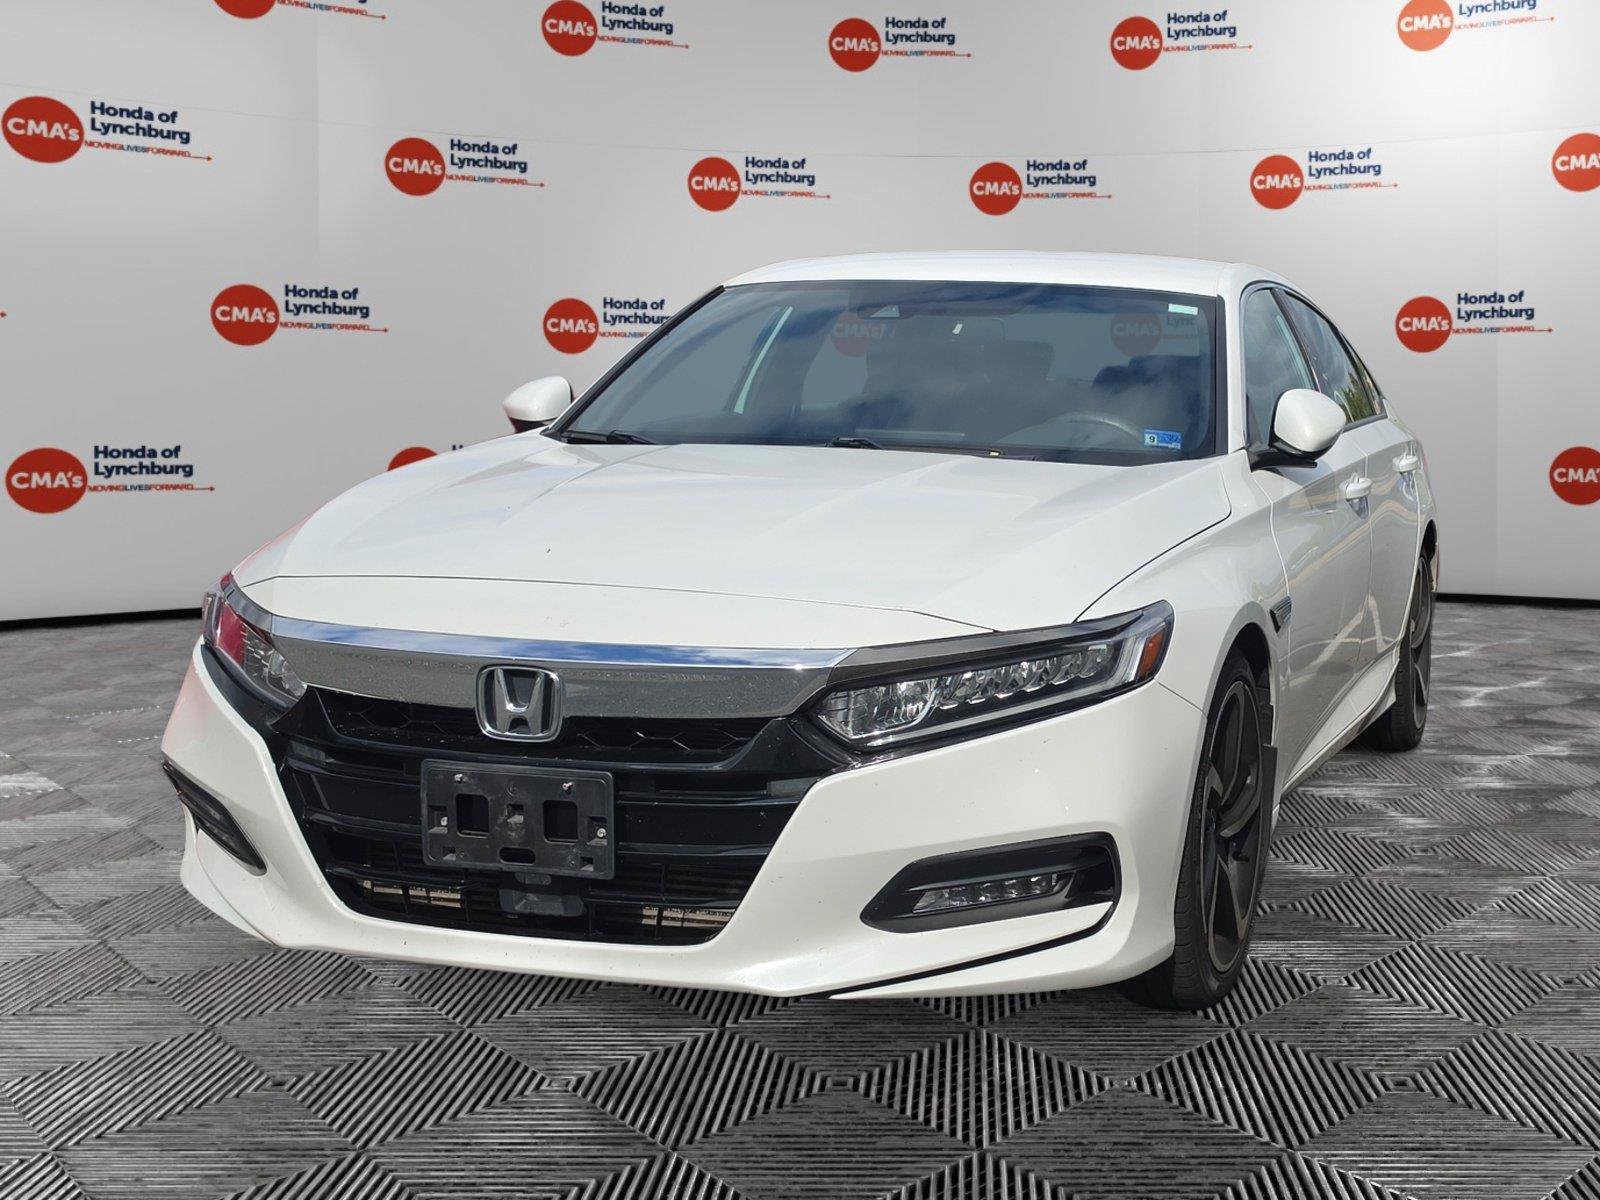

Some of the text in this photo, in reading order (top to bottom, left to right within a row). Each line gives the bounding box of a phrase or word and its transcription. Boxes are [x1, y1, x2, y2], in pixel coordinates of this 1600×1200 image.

[602, 1, 665, 17] Honda of
[1458, 0, 1537, 17] Lynchburg
[602, 15, 674, 35] Lynchburg
[885, 17, 946, 29] Honda of
[1167, 10, 1227, 24] Honda of
[1400, 13, 1451, 32] CMA's
[545, 19, 595, 37] CMA's
[1167, 25, 1237, 40] Lynchburg
[832, 37, 879, 51] CMA's
[885, 31, 956, 45] Lynchburg
[1113, 35, 1160, 50] CMA's
[90, 101, 178, 124] Honda of
[6, 117, 80, 141] CMA's
[90, 117, 191, 144] Lynchburg
[450, 139, 518, 155] Honda of
[1308, 148, 1371, 162] Honda of
[389, 157, 443, 175] CMA's
[450, 154, 528, 173] Lynchburg
[745, 157, 806, 169] Honda of
[1026, 159, 1087, 171] Honda of
[1555, 152, 1600, 171] CMA'
[745, 170, 816, 186] Lynchburg
[1308, 163, 1382, 179] Lynchburg
[691, 176, 739, 192] CMA's
[1026, 173, 1097, 187] Lynchburg
[1253, 173, 1300, 190] CMA's
[972, 181, 1020, 196] CMA's
[284, 284, 359, 300] Honda of
[1457, 290, 1525, 304] Honda of
[284, 299, 370, 319] Lynchburg
[603, 297, 665, 310] Honda of
[214, 305, 276, 324] CMA's
[603, 311, 670, 325] Lynchbur
[1457, 306, 1535, 322] Lynchburg
[546, 317, 596, 333] CMA's
[1398, 316, 1449, 332] CMA's
[93, 445, 181, 459] Honda of
[93, 461, 194, 478] Lynchburg
[1553, 467, 1600, 483] CMA'
[11, 471, 84, 489] CMA's
